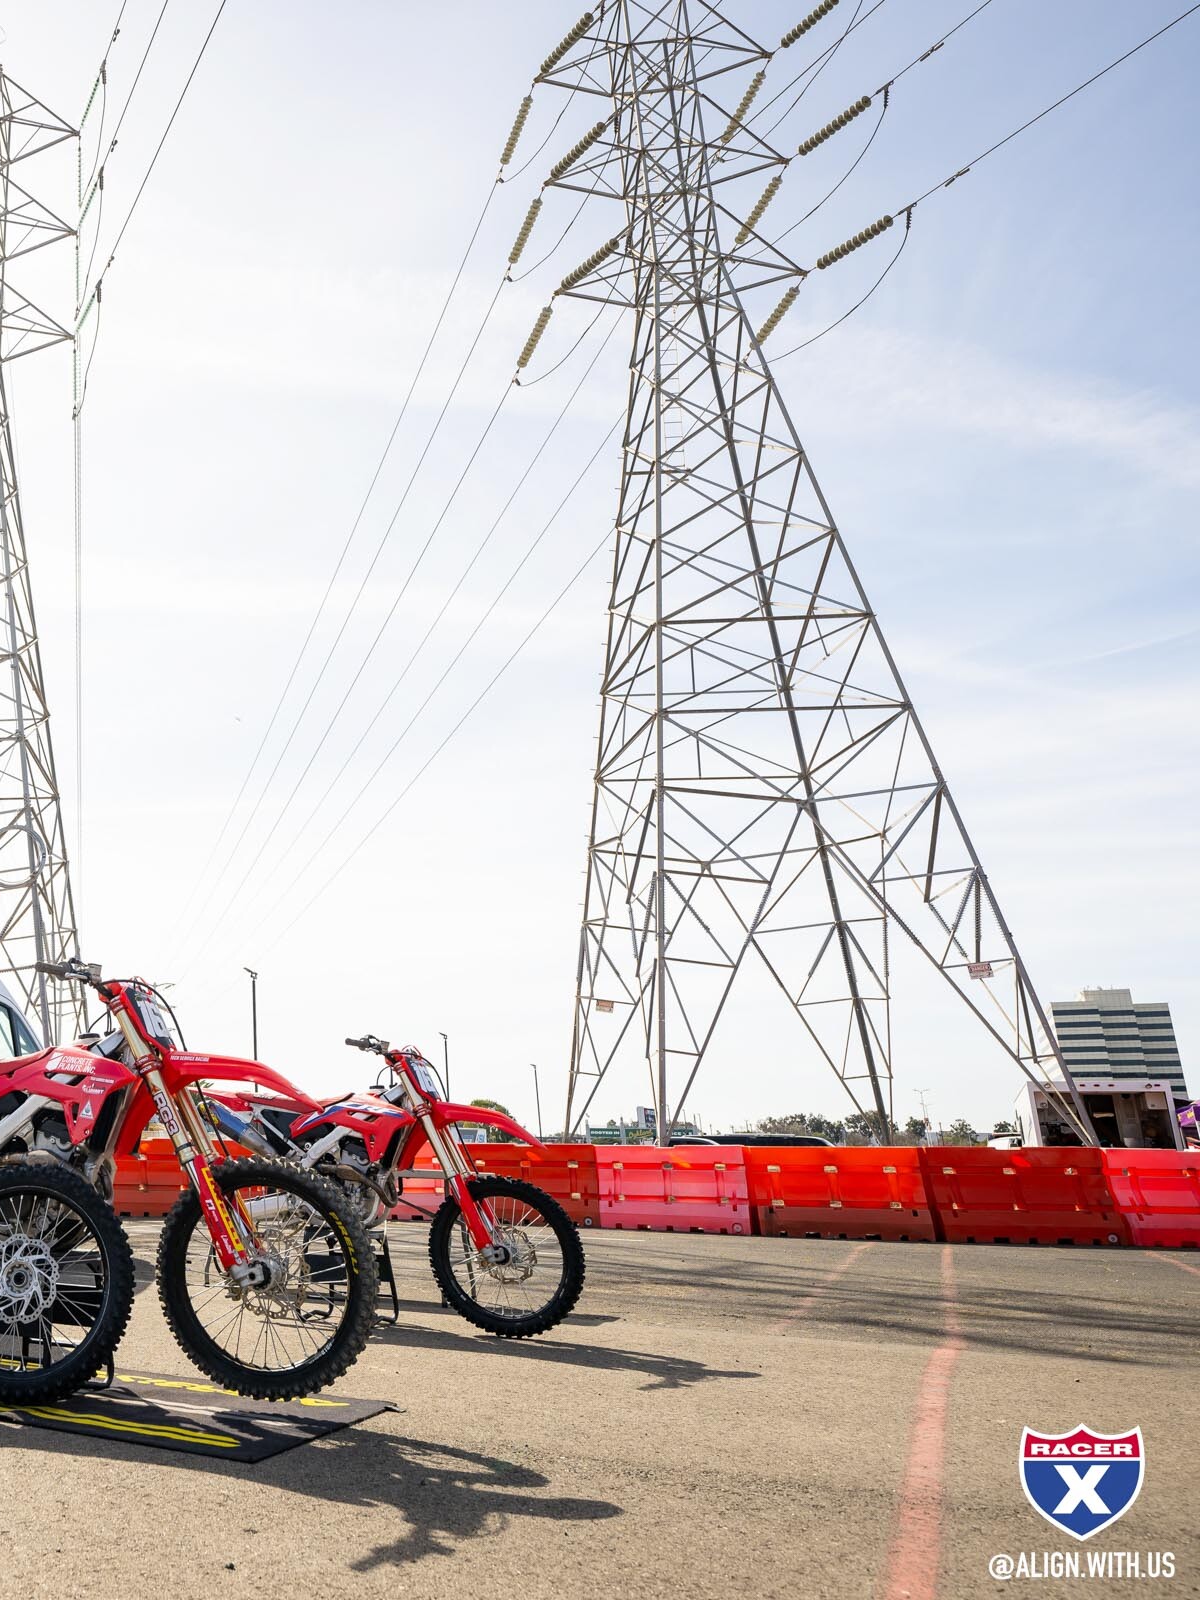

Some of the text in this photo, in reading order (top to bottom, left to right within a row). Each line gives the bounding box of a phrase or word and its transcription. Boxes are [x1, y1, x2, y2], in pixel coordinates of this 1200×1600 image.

[62, 1055, 94, 1066] CONCRETE
[153, 1092, 180, 1137] RG3
[329, 1211, 359, 1275] PIRELLI
